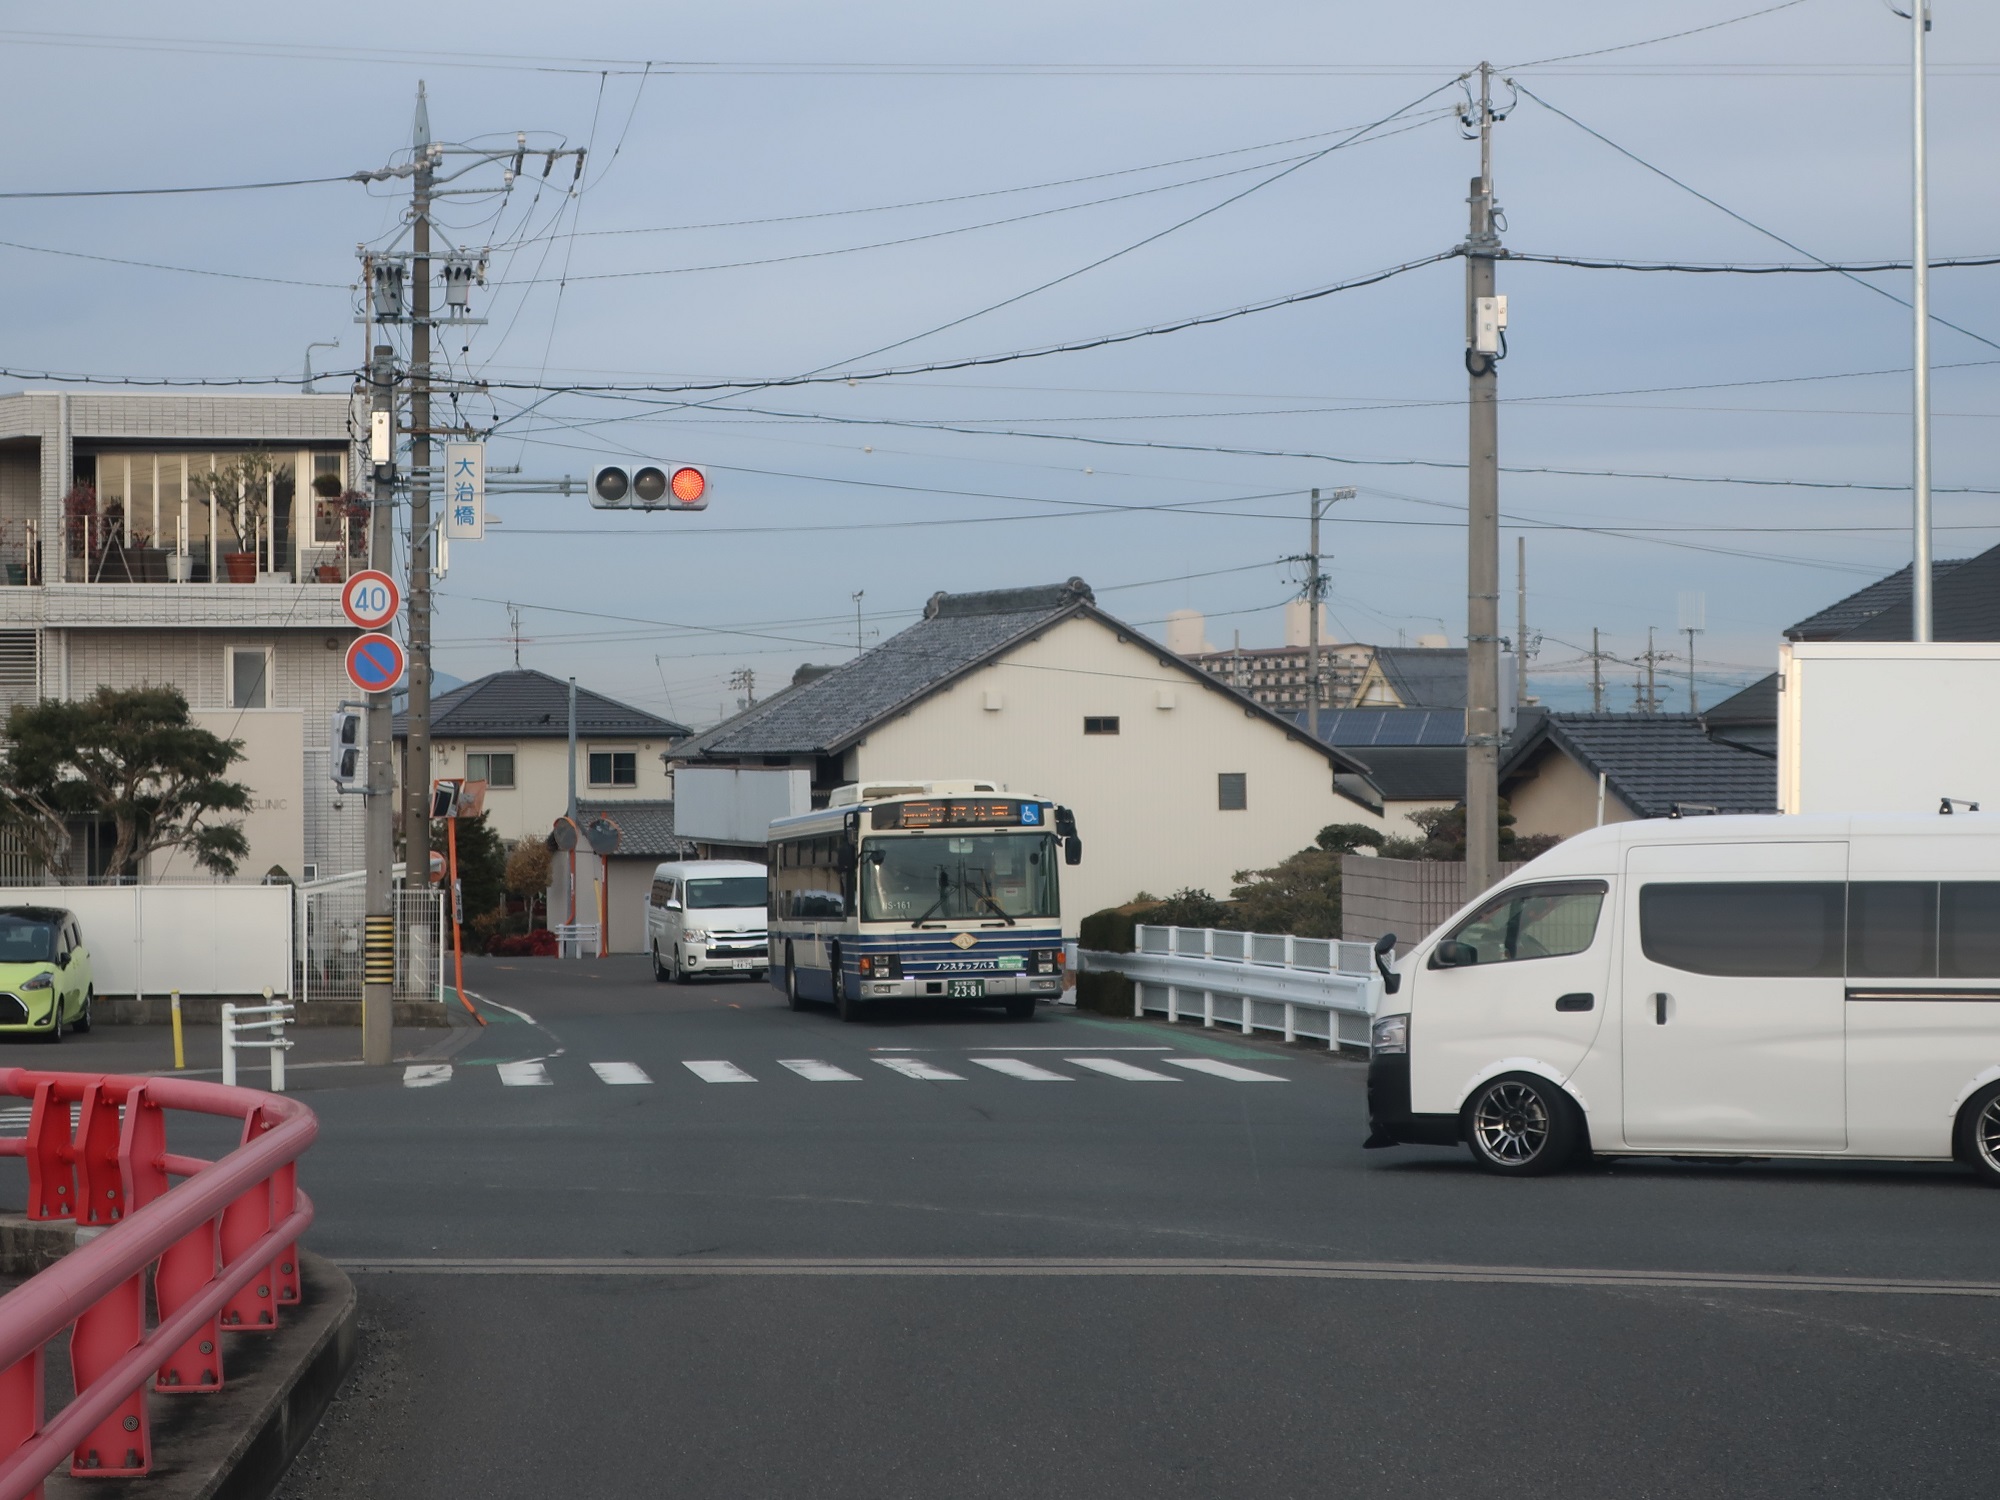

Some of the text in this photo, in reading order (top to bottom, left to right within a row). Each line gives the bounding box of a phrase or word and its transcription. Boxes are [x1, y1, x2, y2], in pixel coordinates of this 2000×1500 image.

[454, 458, 475, 526] 大治橋
[355, 587, 386, 612] 40
[251, 799, 287, 810] CLINIC
[936, 961, 995, 970] ノンステップバス
[954, 985, 982, 997] 23-81
